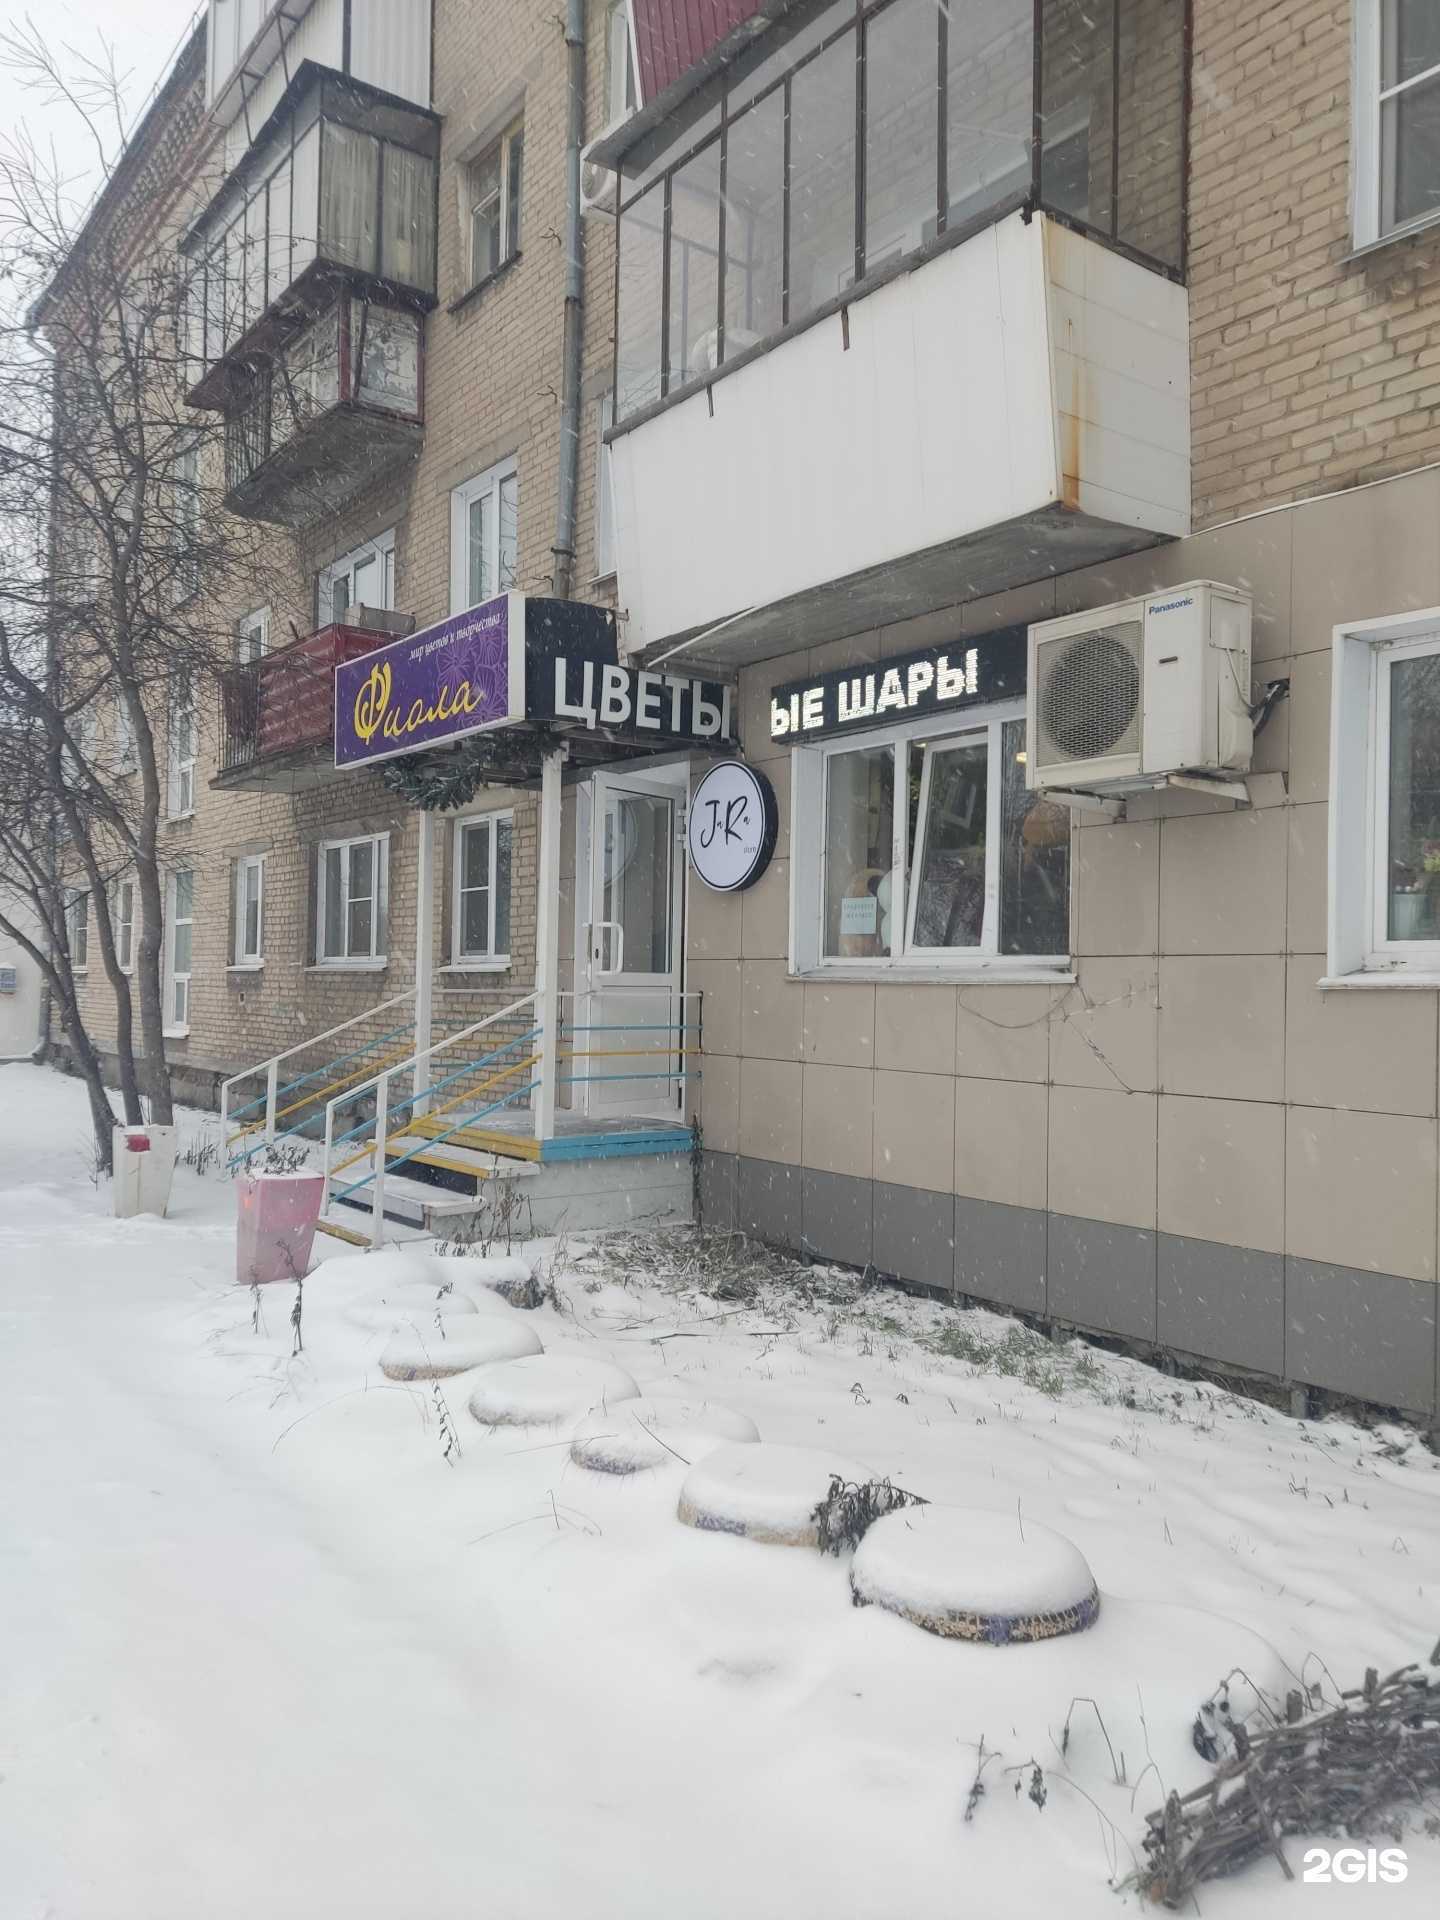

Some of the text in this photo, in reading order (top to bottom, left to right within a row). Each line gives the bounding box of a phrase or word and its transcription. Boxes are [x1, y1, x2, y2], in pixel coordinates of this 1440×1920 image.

[409, 646, 424, 662] мир
[425, 634, 449, 656] цветов
[449, 633, 455, 643] и
[1149, 598, 1193, 615] Panasonic
[354, 662, 484, 745] Фиола
[555, 657, 731, 740] ЦВЕТЫ
[770, 648, 978, 737] ЫЕ ШАРЫ
